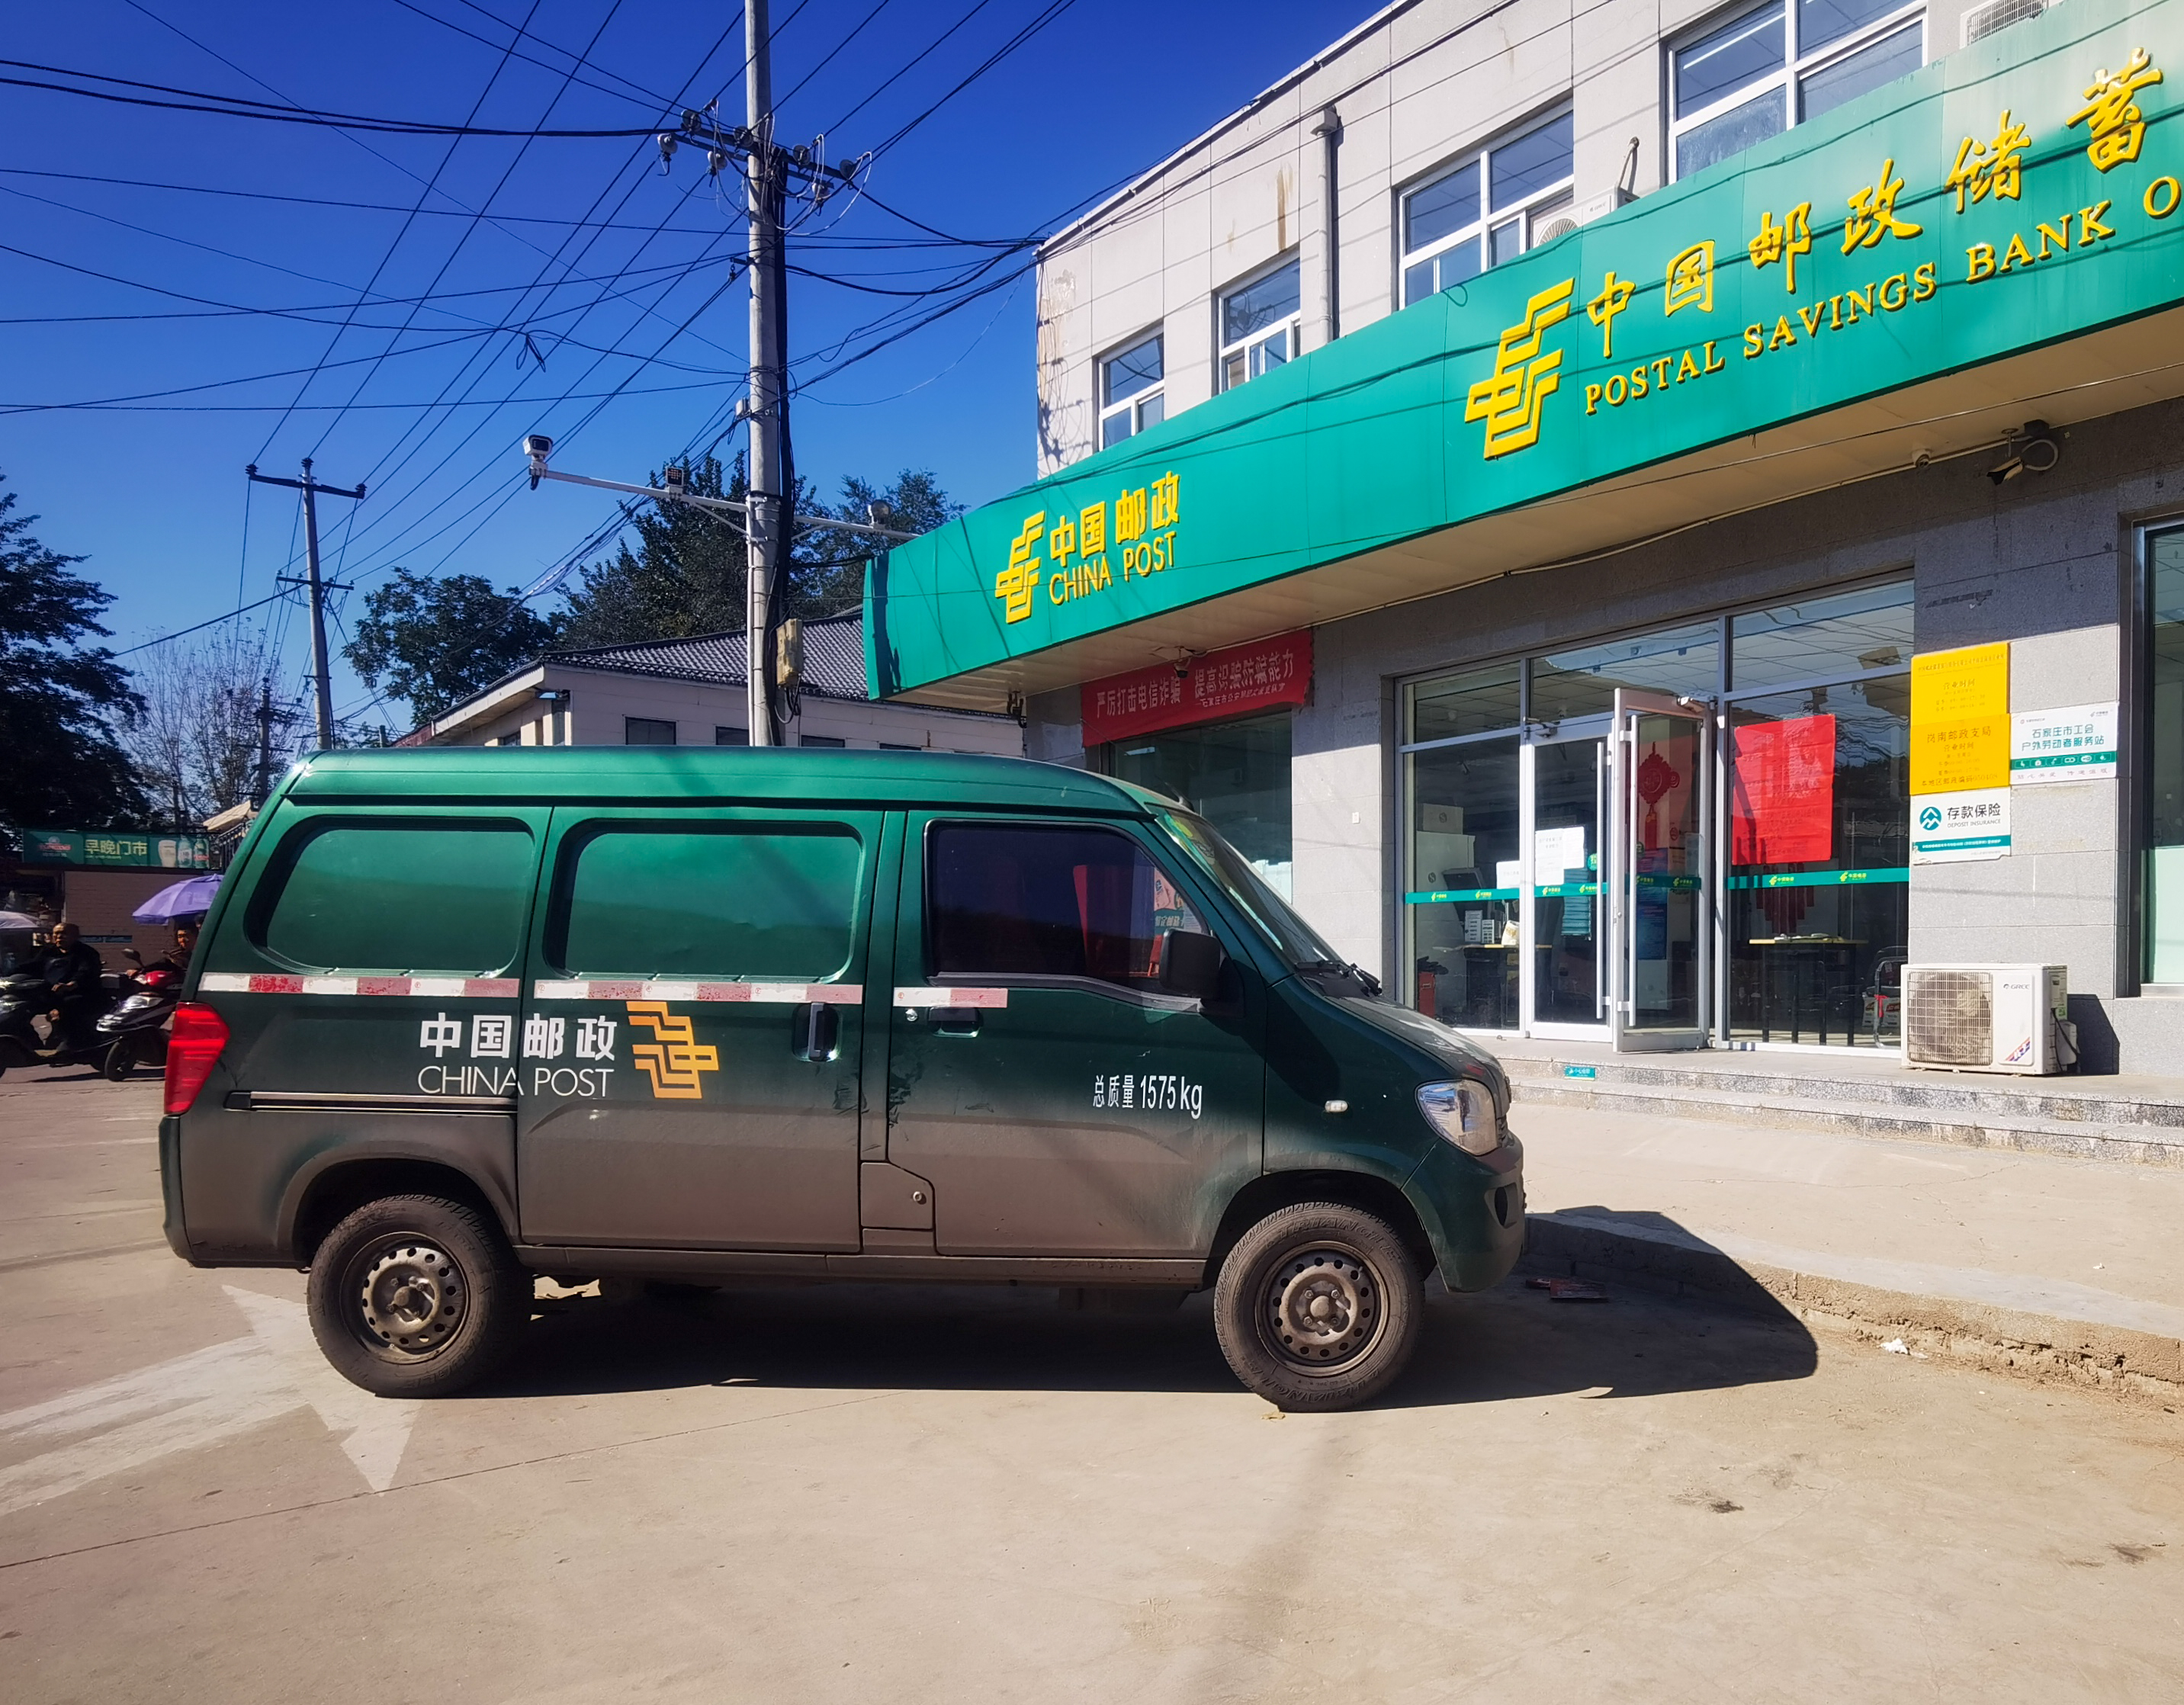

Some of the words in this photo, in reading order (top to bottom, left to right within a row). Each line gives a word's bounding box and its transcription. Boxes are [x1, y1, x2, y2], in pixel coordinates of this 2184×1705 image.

[1585, 47, 2163, 358] 中国邮政储蓄
[1585, 340, 1726, 415] POSTAL
[1743, 262, 1937, 360] SAVINGS
[1965, 199, 2116, 284] BANK
[1049, 470, 1180, 567] 中国邮政
[1049, 555, 1113, 605] CHINA
[1123, 530, 1177, 583] POST
[1096, 674, 1182, 719] 严厉打击电信诈骗
[1194, 648, 1294, 700] 提高识骗防骗能力
[1926, 725, 1992, 744] 岗南邮政支局
[2021, 735, 2105, 752] 户外劳动者服务站
[2031, 723, 2094, 739] 石家庄市工会
[1947, 802, 2001, 820] 存款保险
[84, 839, 148, 856] 早晚门市
[419, 1012, 618, 1061] 中国邮政
[418, 1065, 525, 1096] CHINA
[534, 1068, 615, 1097] POST
[1093, 1074, 1135, 1108] 总质量
